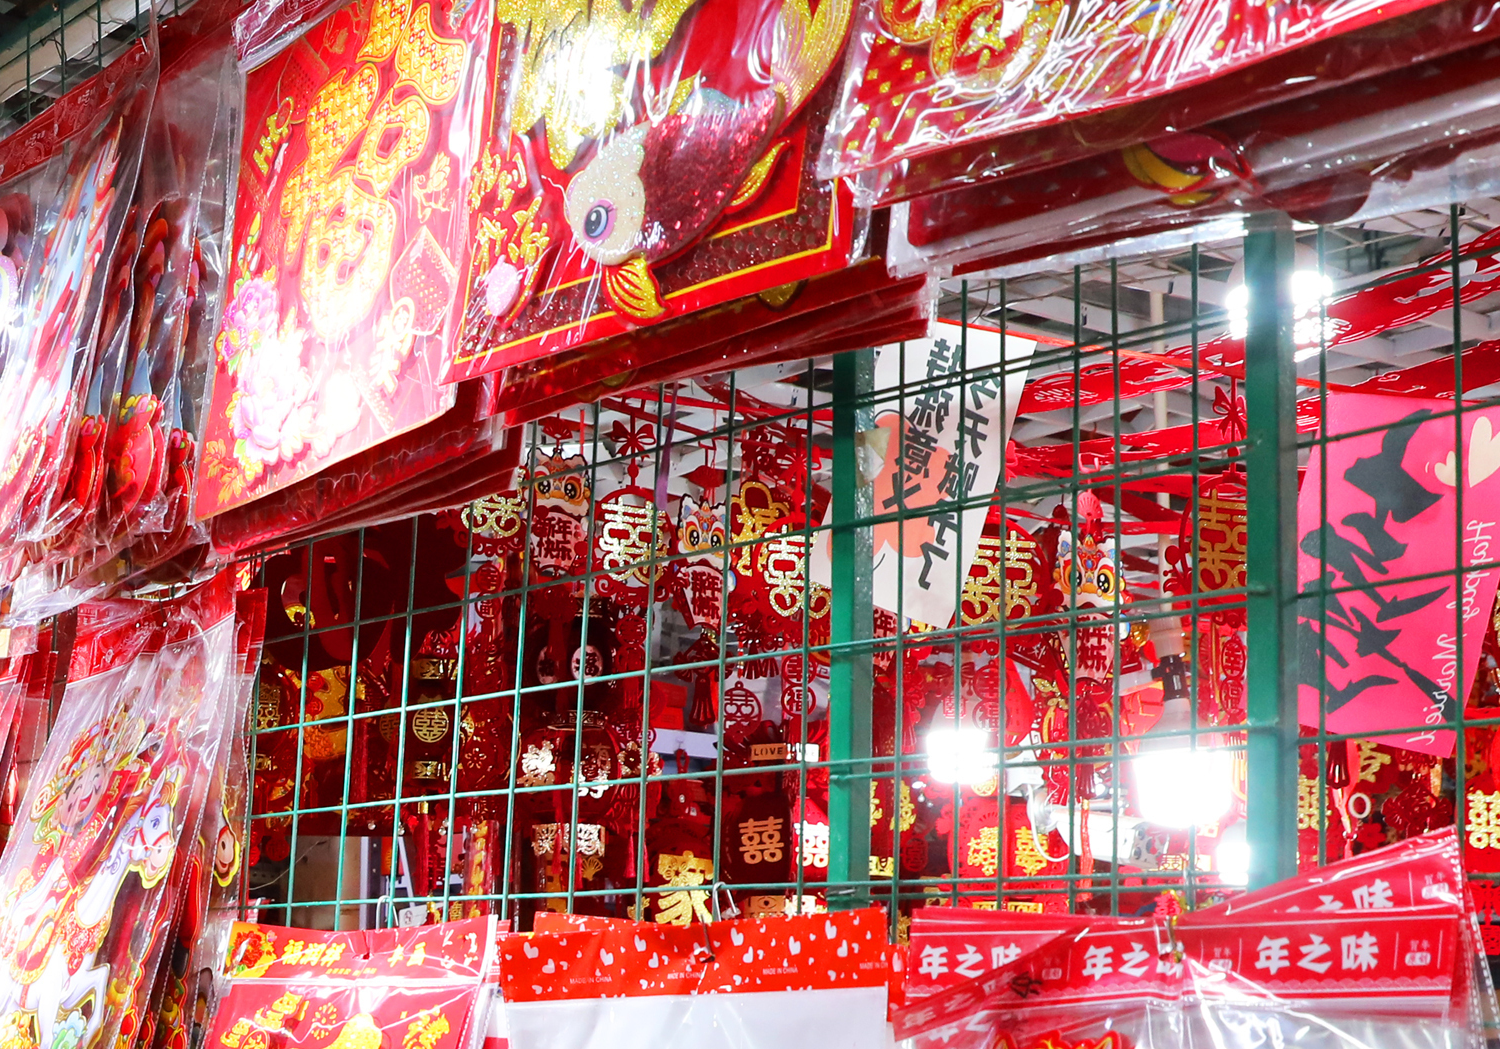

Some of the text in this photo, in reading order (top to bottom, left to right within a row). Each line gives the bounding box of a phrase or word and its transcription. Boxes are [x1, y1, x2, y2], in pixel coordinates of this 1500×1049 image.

[918, 942, 1023, 980] 年之味
[1254, 931, 1380, 975] 年之味
